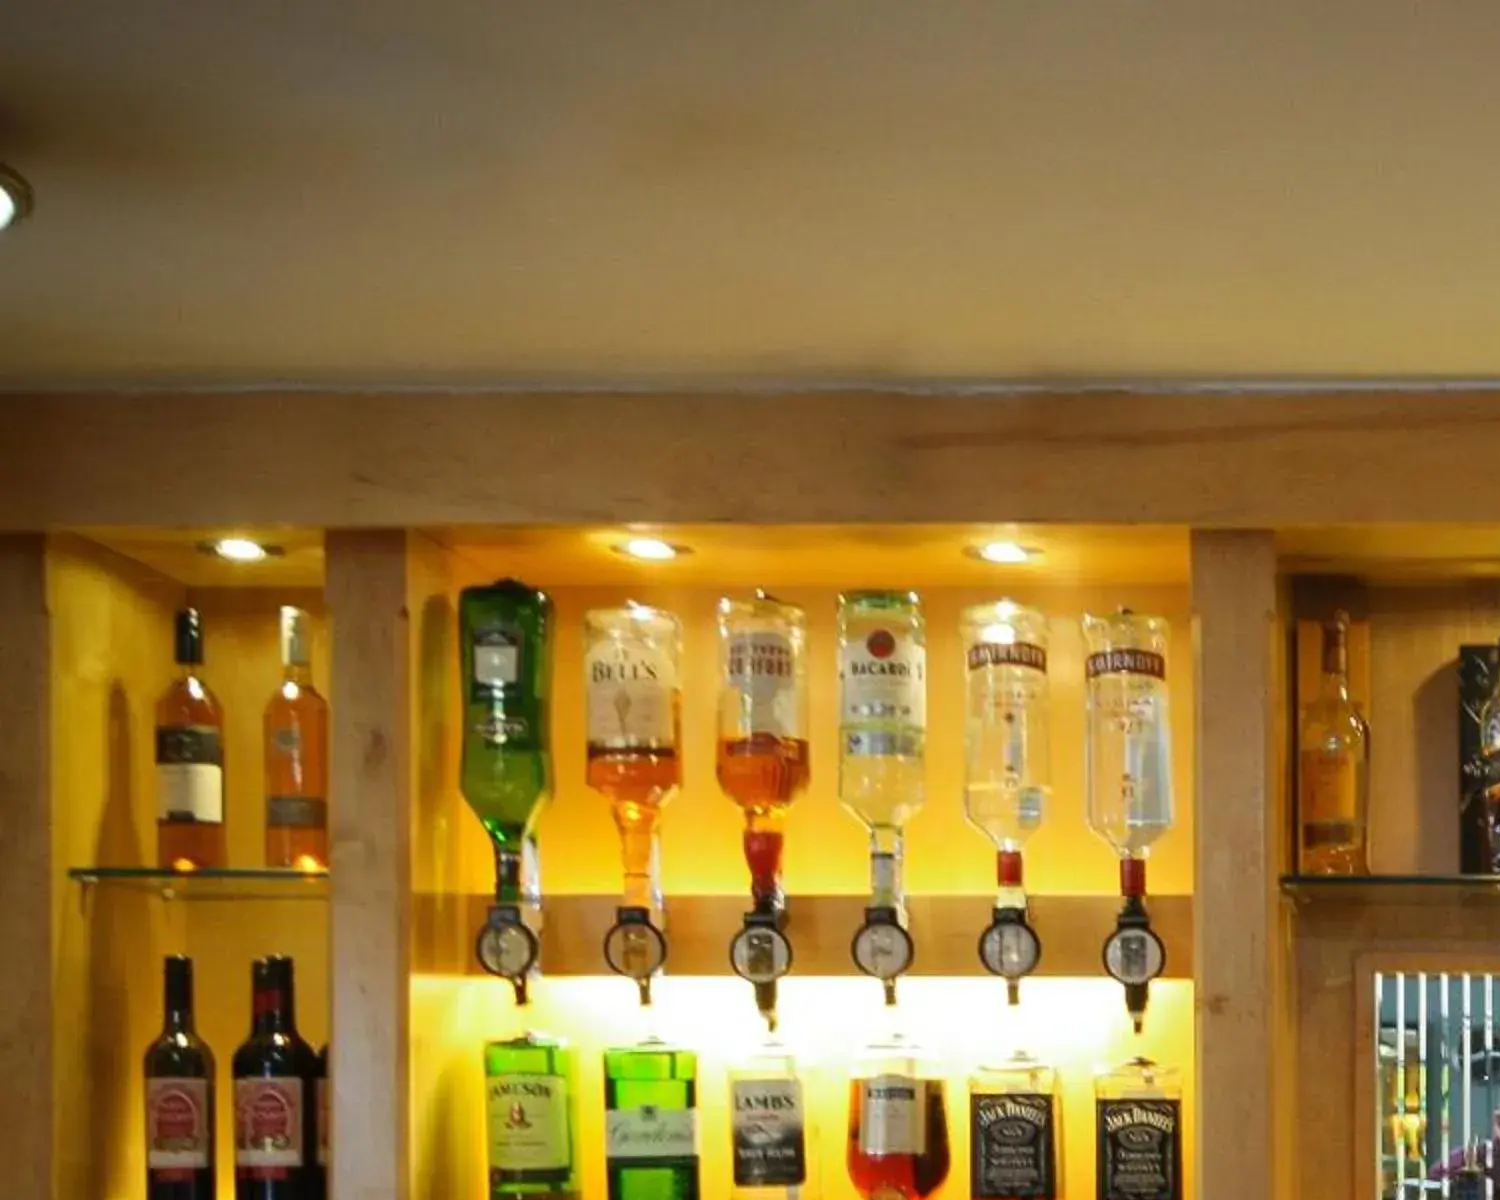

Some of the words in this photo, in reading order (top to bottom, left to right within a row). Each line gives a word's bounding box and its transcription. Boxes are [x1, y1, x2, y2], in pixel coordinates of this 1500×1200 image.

[592, 659, 658, 683] BELL'S
[850, 661, 911, 677] BACARDI
[1087, 650, 1164, 679] SMIRNOFF
[734, 1093, 796, 1112] LAMB'S
[979, 1104, 1005, 1127] JACK
[1106, 1111, 1133, 1132] JACK
[1132, 1106, 1175, 1134] DANIEL'S
